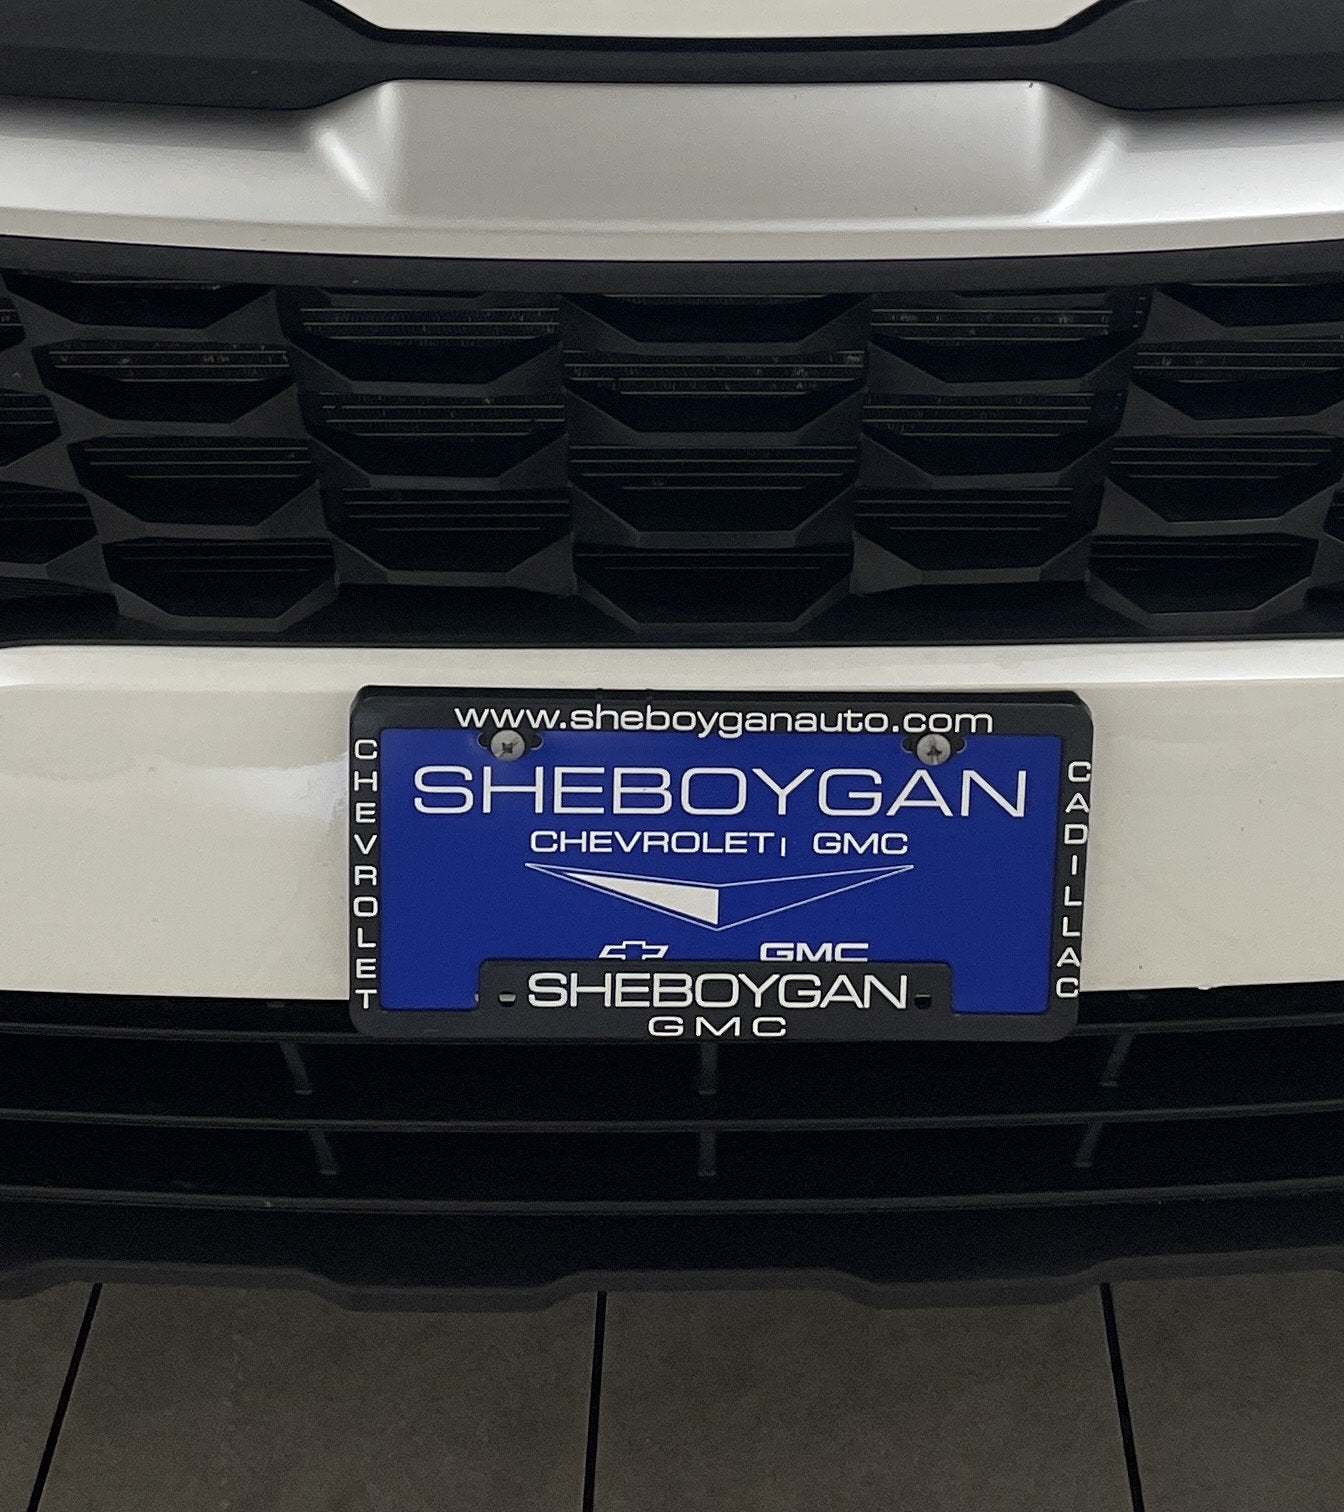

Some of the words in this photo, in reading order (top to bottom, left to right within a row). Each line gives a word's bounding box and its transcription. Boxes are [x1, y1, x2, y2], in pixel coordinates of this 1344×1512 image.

[454, 703, 994, 739] www.sheboyganauto.com
[413, 764, 1027, 818] SHEBOYGAN
[529, 830, 776, 855] CHEVROLET
[812, 832, 909, 856] GMC
[352, 738, 379, 1010] CHEVROLET
[1056, 760, 1091, 999] CADILLAC
[759, 942, 870, 963] GMC
[527, 971, 908, 1010] SHEBOYGAN
